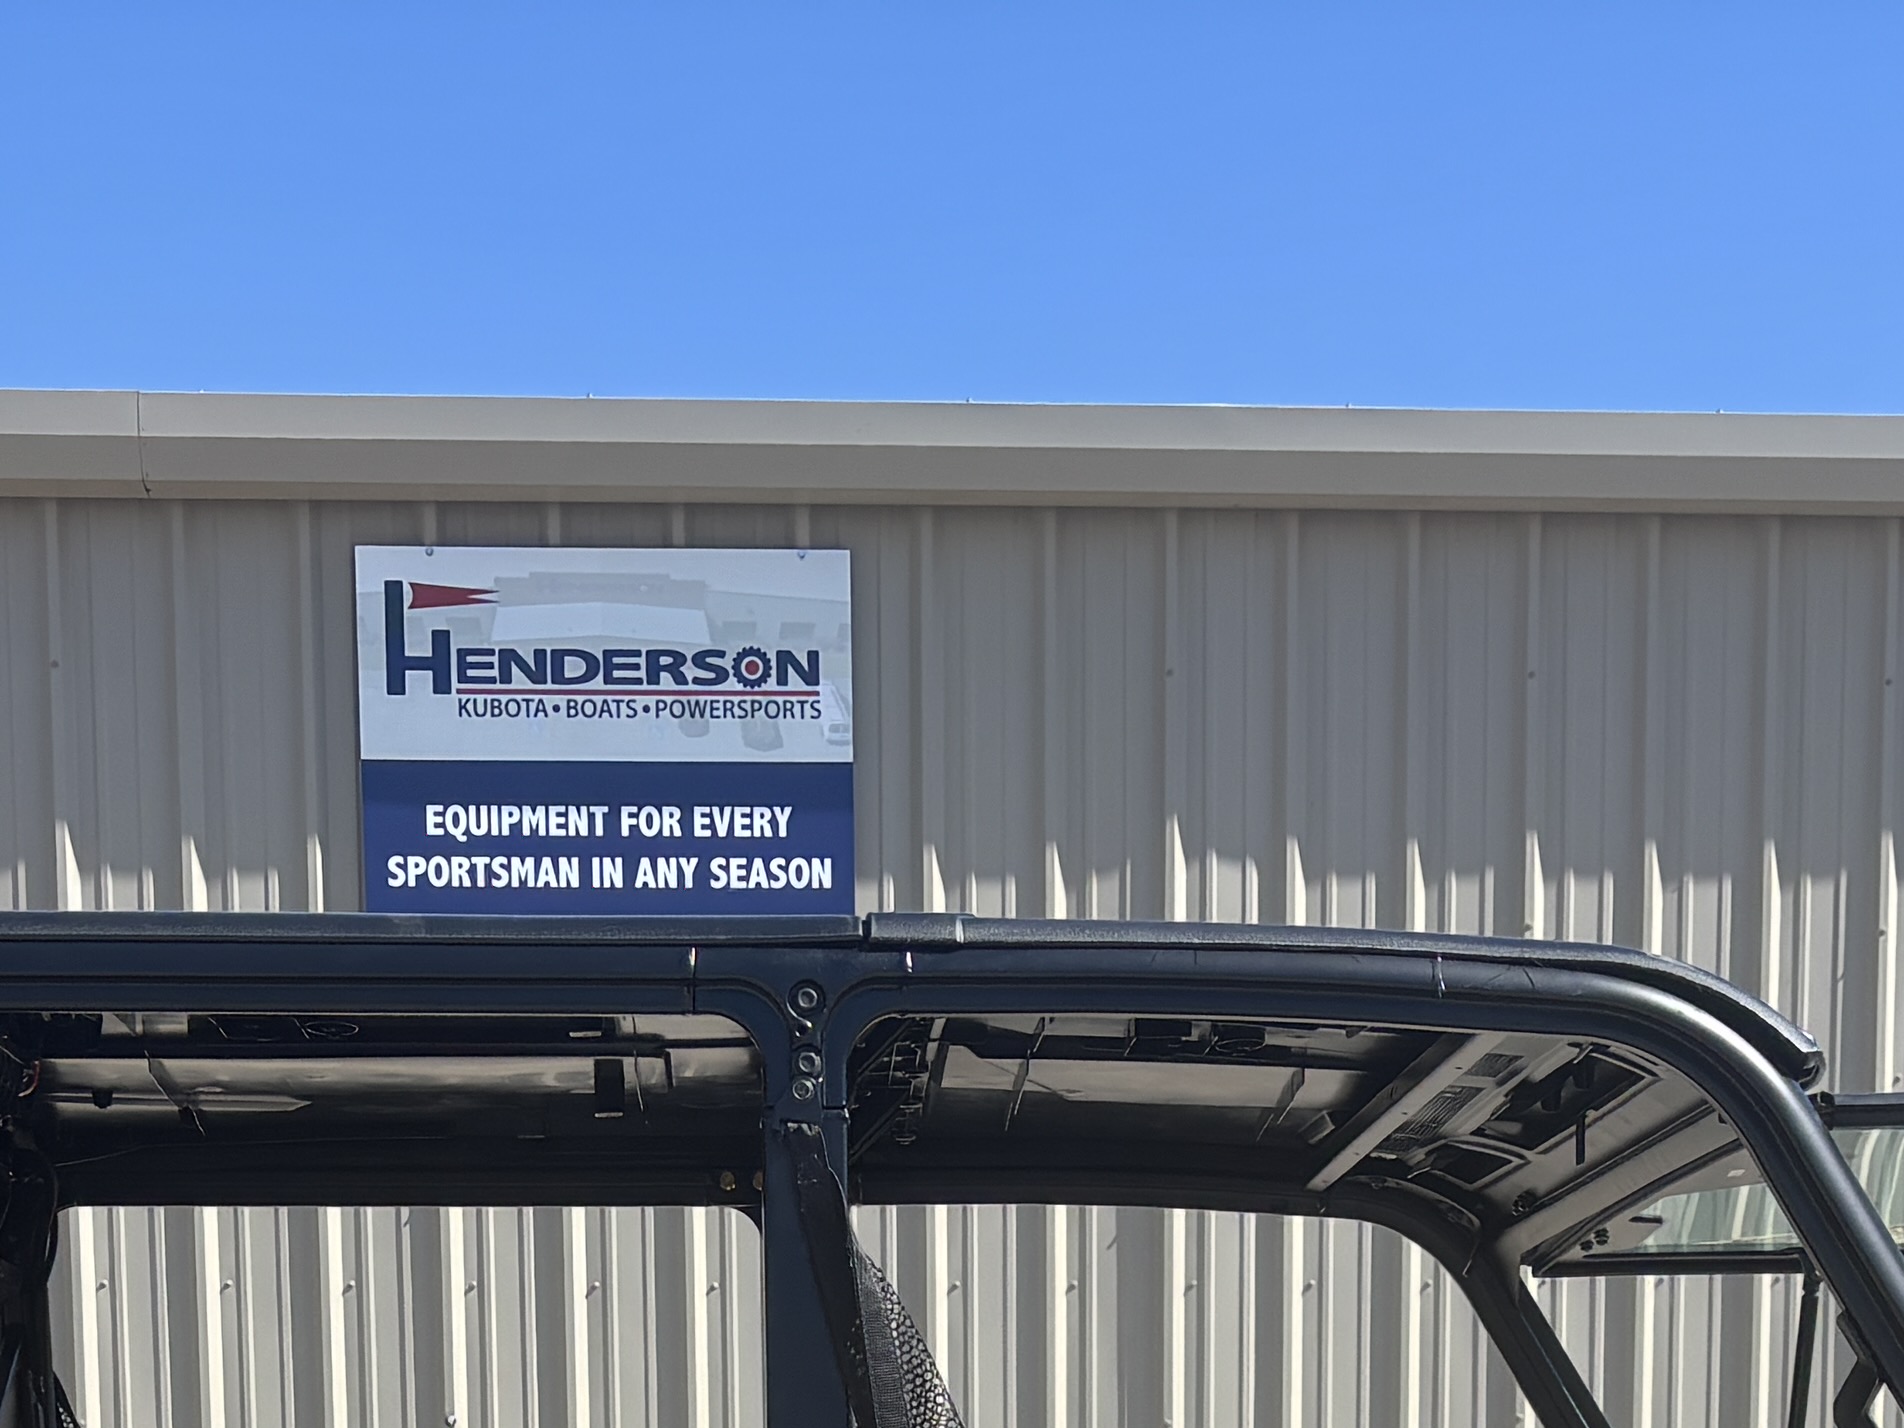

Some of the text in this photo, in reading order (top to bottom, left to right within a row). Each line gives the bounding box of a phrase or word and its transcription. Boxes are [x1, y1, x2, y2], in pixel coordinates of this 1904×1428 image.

[384, 580, 821, 695] HENDERSON
[458, 698, 822, 721] KUBOTA BOATS POWERSPORTS
[425, 804, 793, 843] EQUIPMENT FOR EVERY
[387, 855, 833, 890] SPORTSMAN IN ANY SEASON
